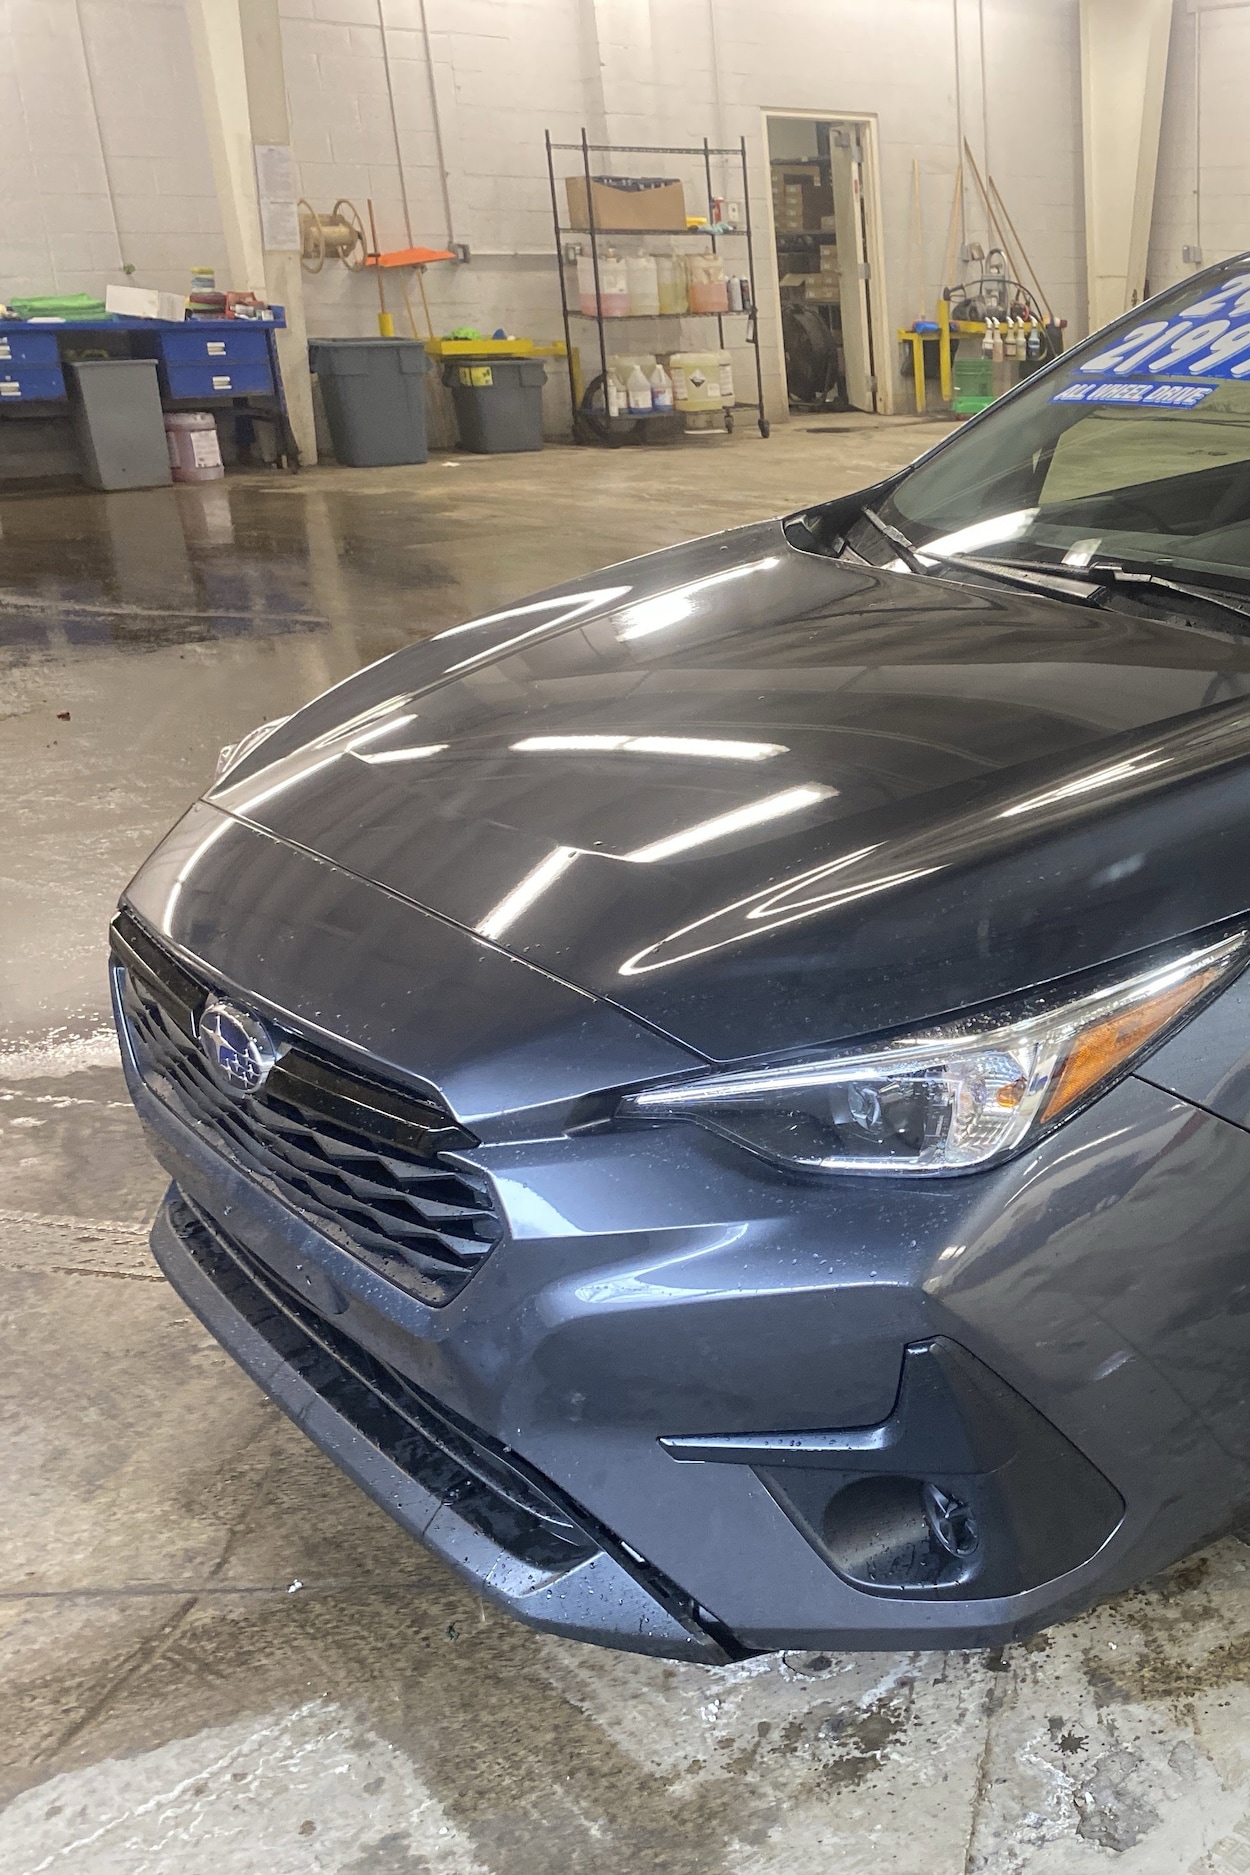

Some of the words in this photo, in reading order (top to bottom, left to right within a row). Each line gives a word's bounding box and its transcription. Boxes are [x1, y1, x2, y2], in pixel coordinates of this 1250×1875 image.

[1053, 384, 1096, 401] ALL
[1086, 384, 1153, 402] WHEEL
[1143, 385, 1213, 405] DRIVE
